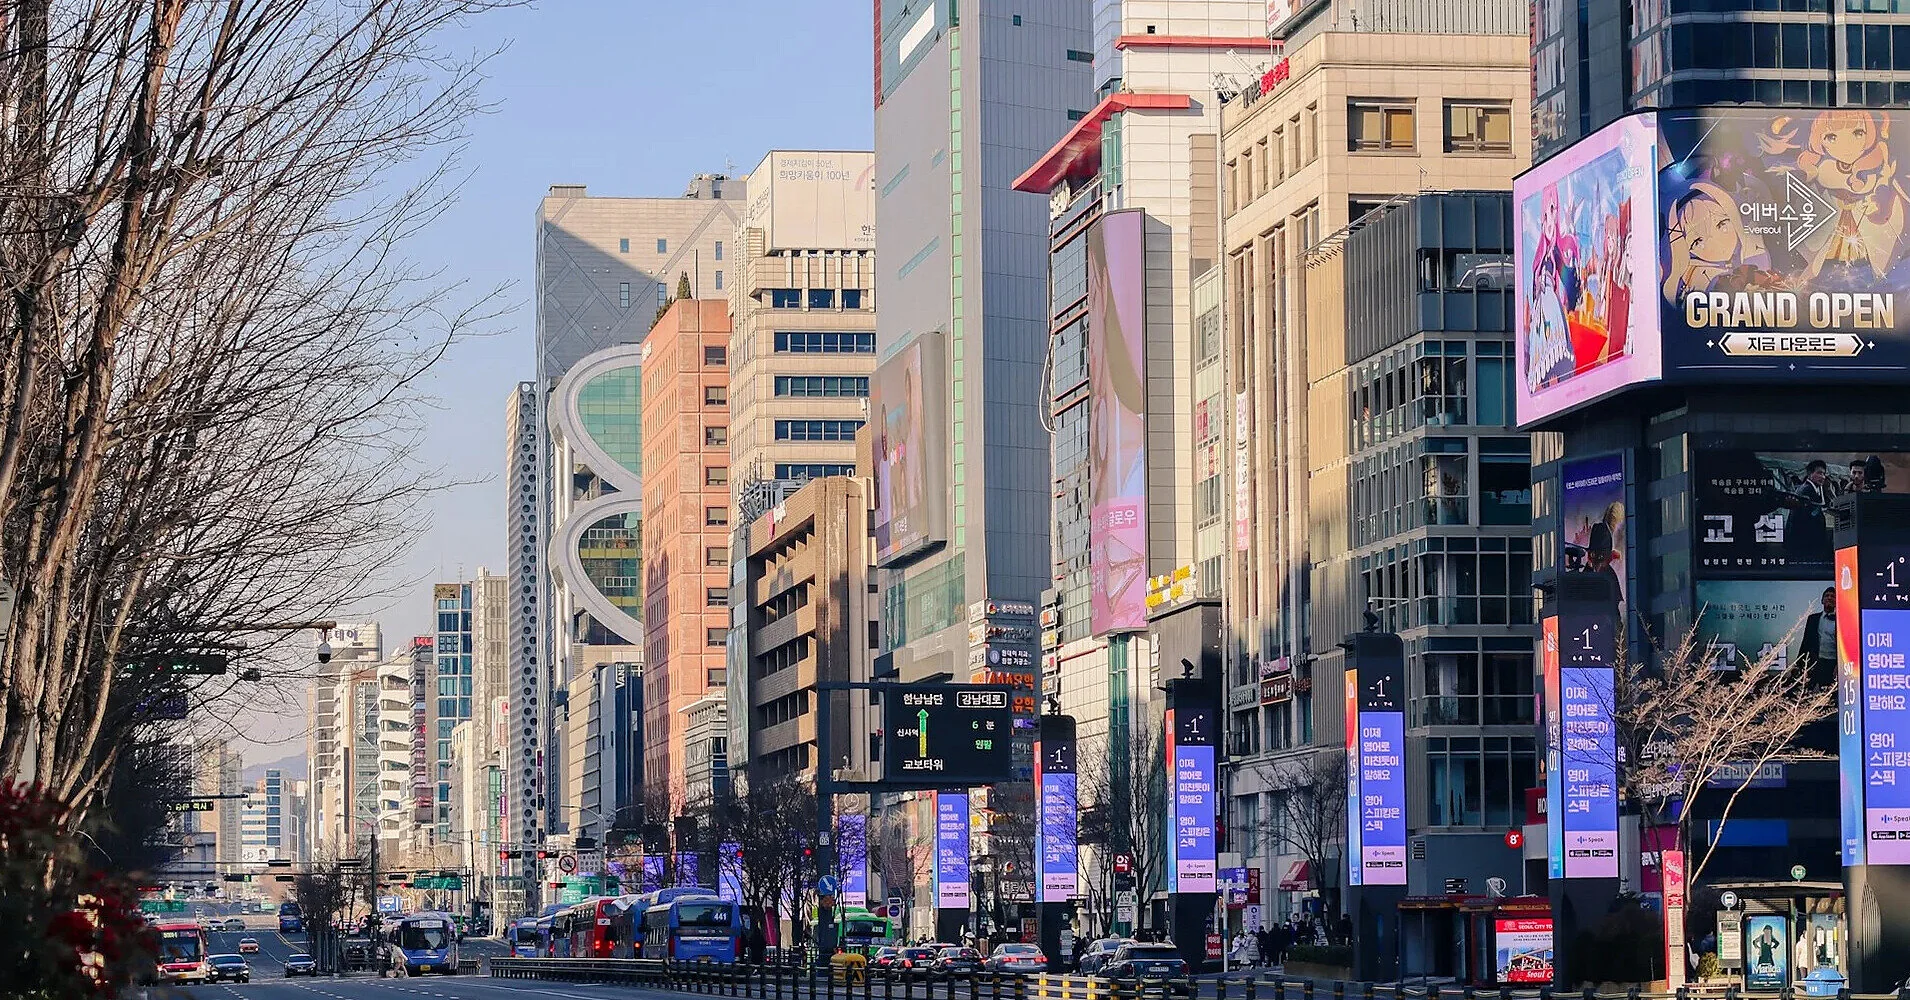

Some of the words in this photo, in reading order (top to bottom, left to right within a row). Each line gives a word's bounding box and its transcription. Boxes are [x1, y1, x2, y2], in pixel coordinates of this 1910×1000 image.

[826, 170, 850, 180] 100년
[1740, 202, 1816, 228] 에버소울
[861, 225, 875, 236] 한
[1744, 225, 1782, 234] Eversoul
[1686, 292, 1797, 328] GRAND
[1809, 292, 1894, 328] OPEN
[1748, 337, 1774, 352] 지금
[1781, 337, 1836, 352] 다운로드
[1868, 632, 1892, 647] 이제
[1868, 653, 1905, 668] 영어로
[1844, 662, 1854, 676] SAT
[616, 664, 625, 688] VANS
[904, 694, 943, 705] 한남남단
[962, 694, 1002, 705] 강남대로
[1566, 687, 1588, 699] 이제
[1844, 680, 1855, 706] 15
[1869, 695, 1906, 710] 말해요
[1567, 704, 1598, 717] 영어로
[972, 720, 979, 729] 6
[986, 720, 995, 730] 분
[1844, 710, 1855, 735] 01
[897, 728, 918, 737] 신사역
[1363, 728, 1381, 738] 이제
[975, 740, 992, 750] 원활
[1364, 742, 1390, 752] 영어로
[1870, 733, 1894, 748] 영어
[903, 759, 943, 771] 교보타워
[1568, 769, 1589, 782] 영어
[1870, 770, 1896, 786] 스픽
[1364, 796, 1382, 806] 영어
[1568, 800, 1590, 813] 스픽
[1365, 820, 1383, 831] 스픽
[1116, 855, 1129, 871] 약
[713, 912, 727, 921] 441
[1526, 970, 1545, 978] Seoul
